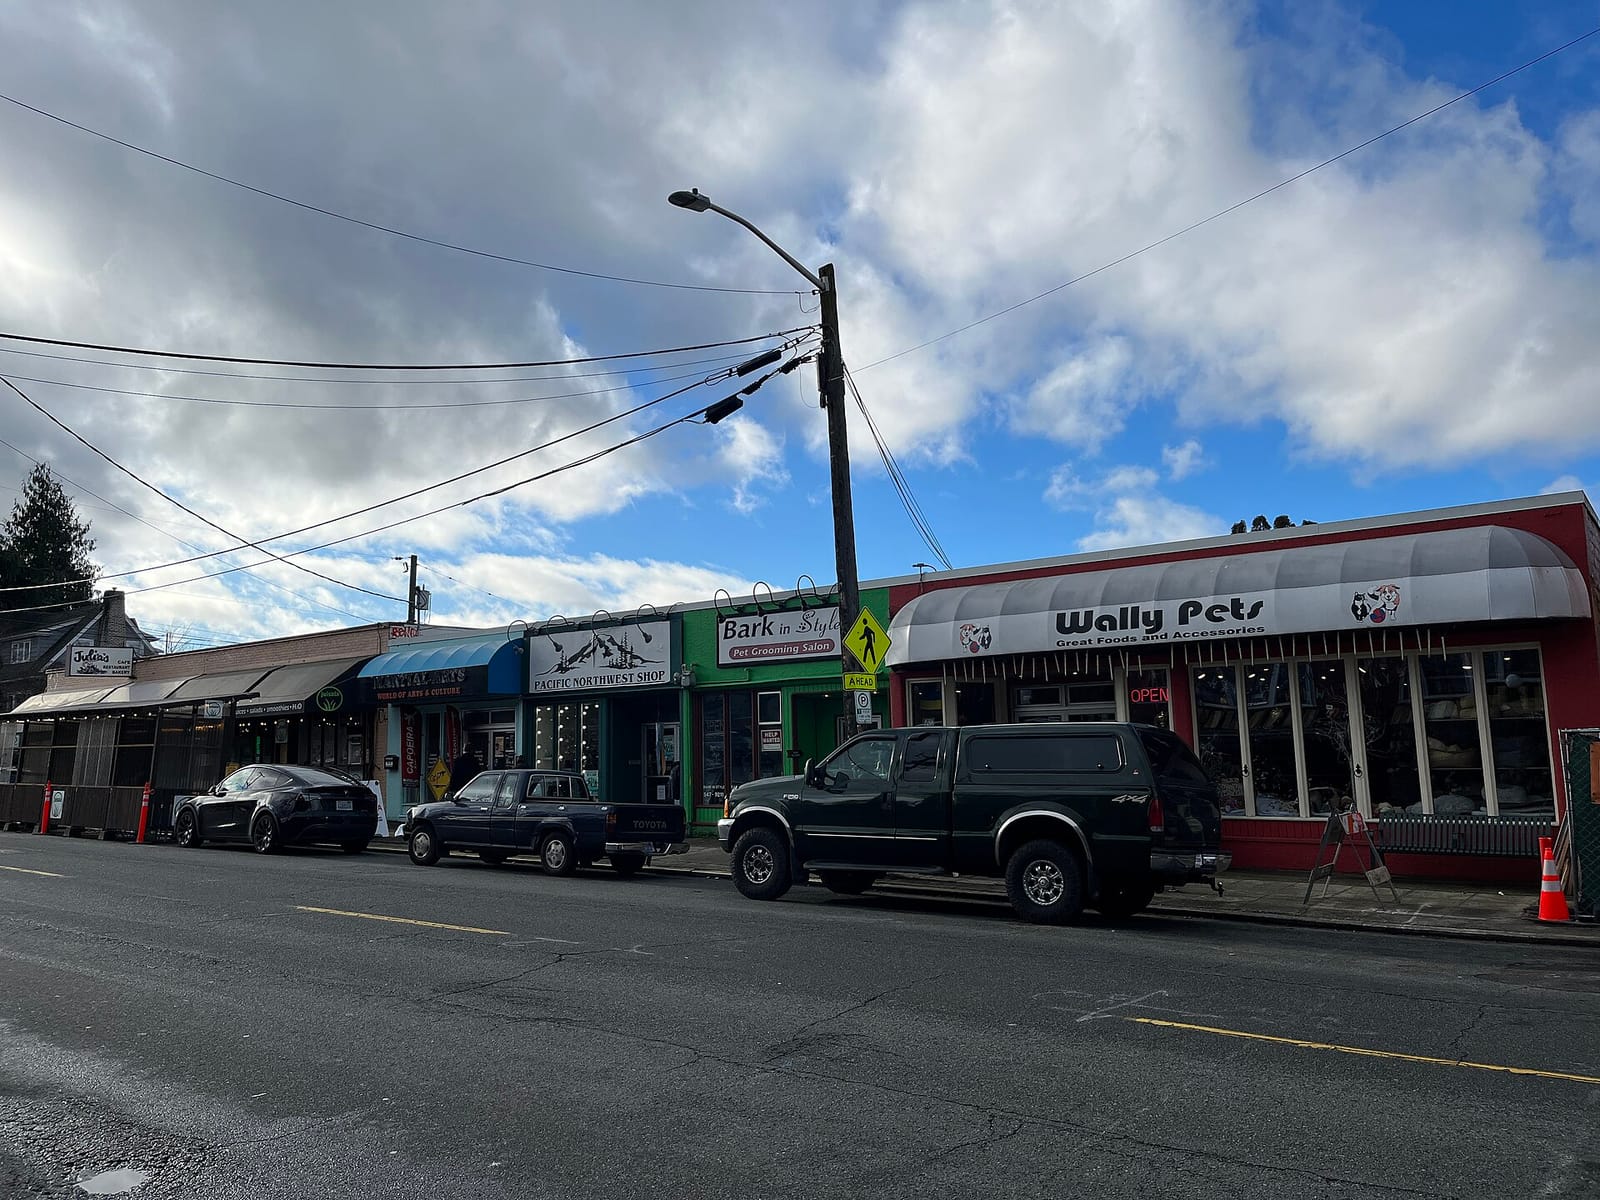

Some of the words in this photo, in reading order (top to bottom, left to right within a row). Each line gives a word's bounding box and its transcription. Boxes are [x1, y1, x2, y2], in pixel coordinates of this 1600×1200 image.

[723, 615, 775, 640] Bark
[779, 623, 791, 635] in
[796, 608, 840, 638] Style
[1056, 606, 1163, 635] Wally
[1178, 598, 1264, 625] Pets
[1056, 638, 1093, 647] Great
[1097, 635, 1137, 645] Foods
[1141, 632, 1168, 642] and
[1173, 625, 1265, 639] Accessories
[74, 649, 109, 662] Julia's
[733, 648, 749, 657] Pet
[751, 644, 799, 656] Grooming
[802, 641, 830, 652] Salon
[534, 678, 571, 690] PACIFIC
[574, 673, 634, 687] NORTHWEST
[637, 670, 666, 683] SHOP
[849, 677, 873, 686] AHEAD
[377, 691, 399, 700] WORLD
[431, 687, 460, 696] CULTURE
[1130, 688, 1169, 703] OPEN
[406, 726, 415, 774] CAPOEIRA
[633, 820, 667, 829] TOYOTA
